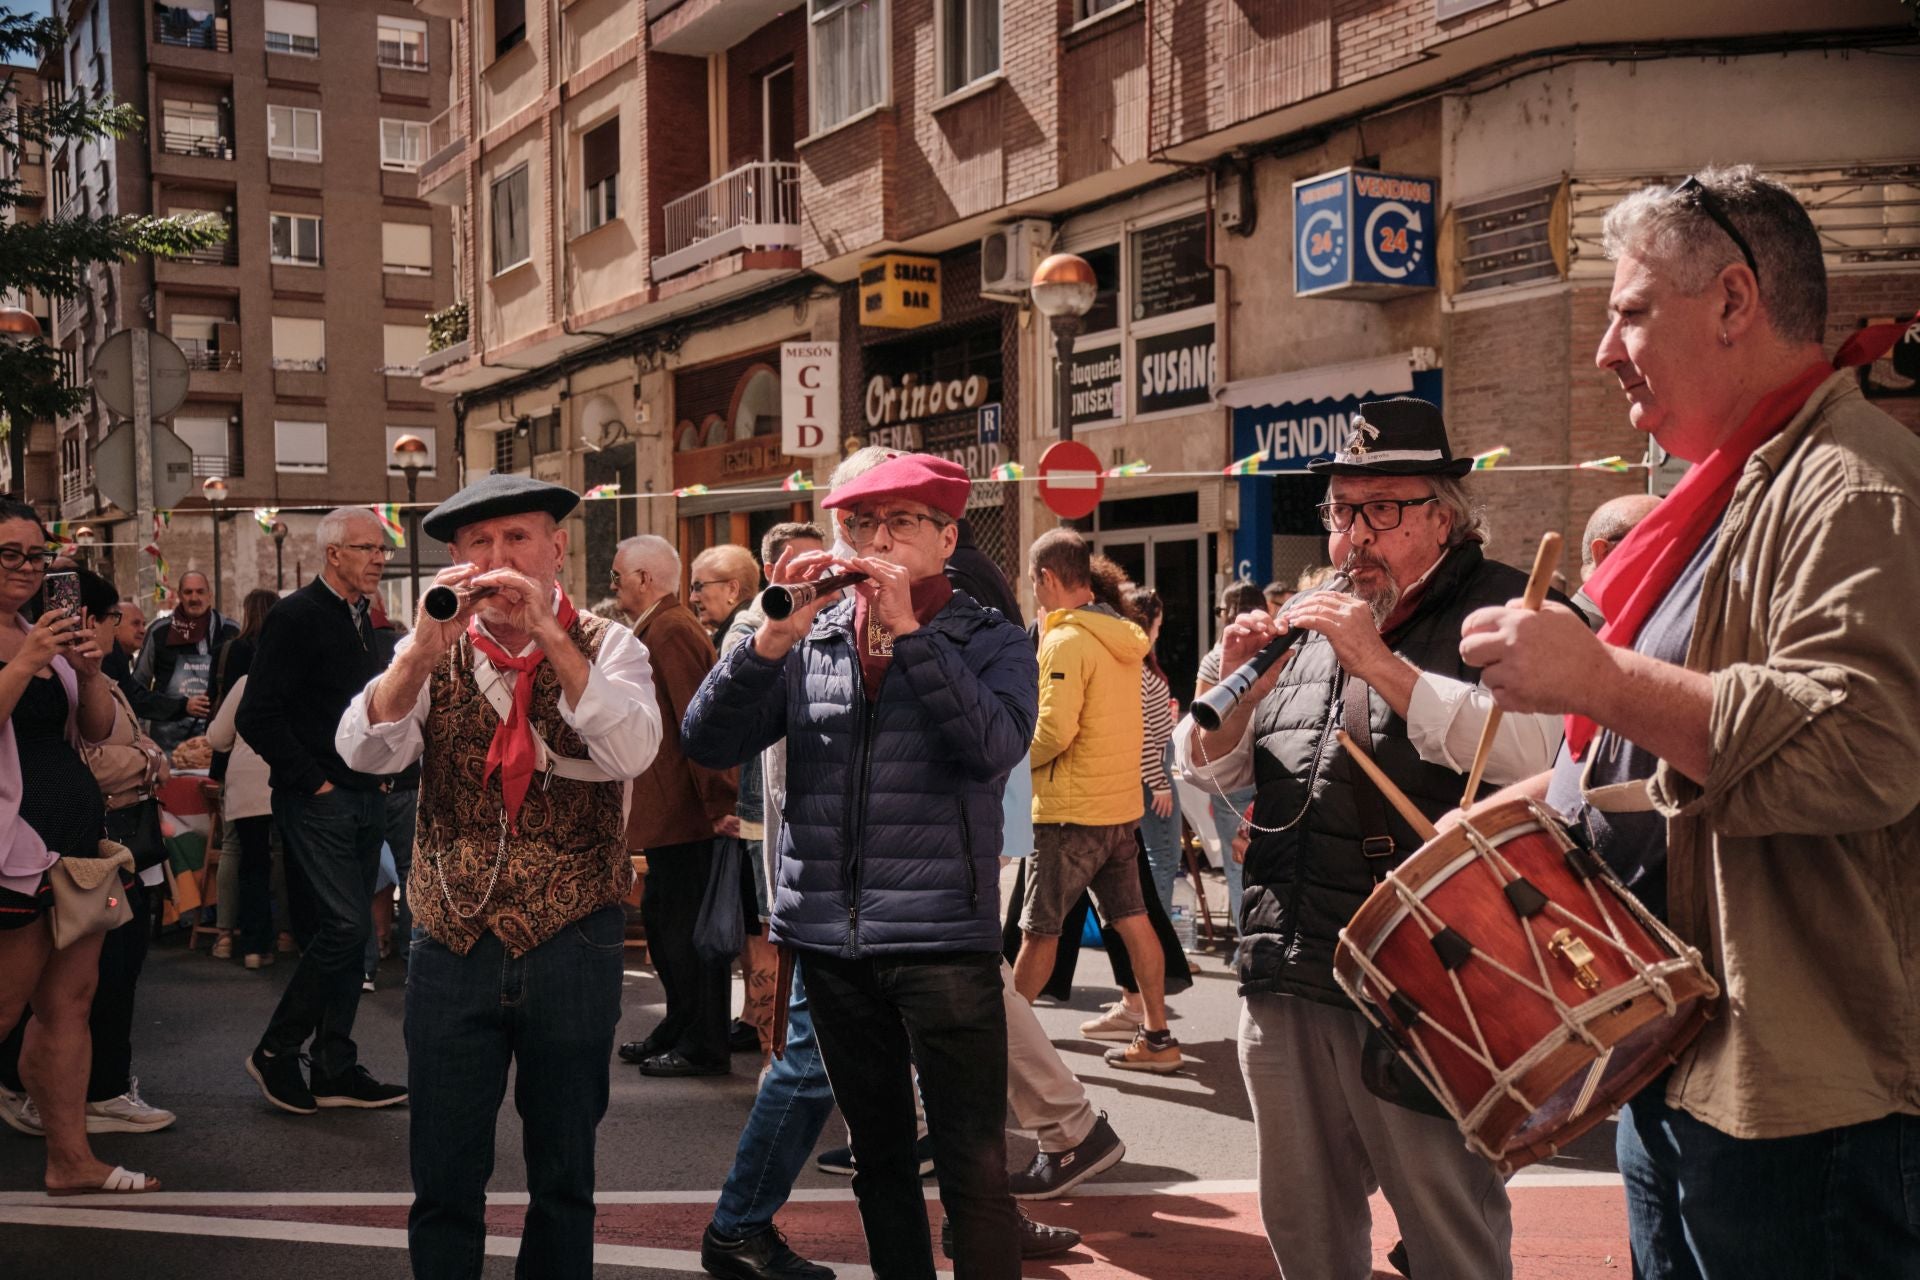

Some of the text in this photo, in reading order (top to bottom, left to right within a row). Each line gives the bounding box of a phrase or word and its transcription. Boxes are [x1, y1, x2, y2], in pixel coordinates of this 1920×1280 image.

[1355, 175, 1431, 203] VENDING
[1311, 231, 1333, 256] 24
[1380, 226, 1408, 253] 24
[902, 290, 930, 308] BAR
[786, 346, 832, 358] MESÓN
[1056, 354, 1121, 387] luqueria
[866, 374, 978, 426] Orinoco
[984, 409, 995, 432] R
[1255, 411, 1357, 460] VENDIN
